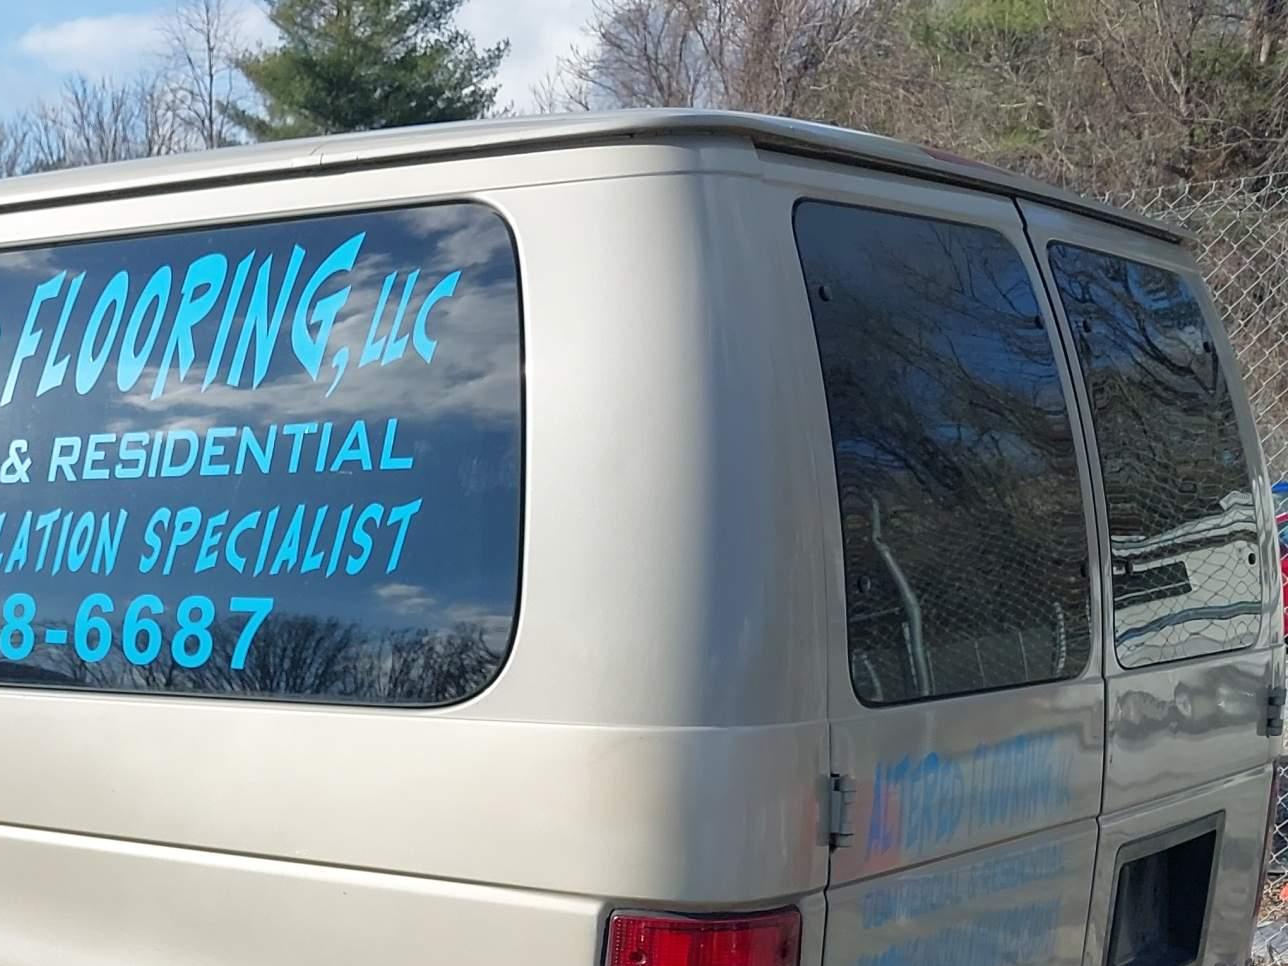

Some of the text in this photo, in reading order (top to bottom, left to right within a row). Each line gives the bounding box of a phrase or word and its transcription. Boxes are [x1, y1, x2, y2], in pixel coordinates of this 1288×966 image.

[359, 269, 462, 367] LLC
[0, 439, 32, 484] &
[48, 418, 414, 482] RESIDENTIAL
[139, 498, 424, 577] SPECIALIST
